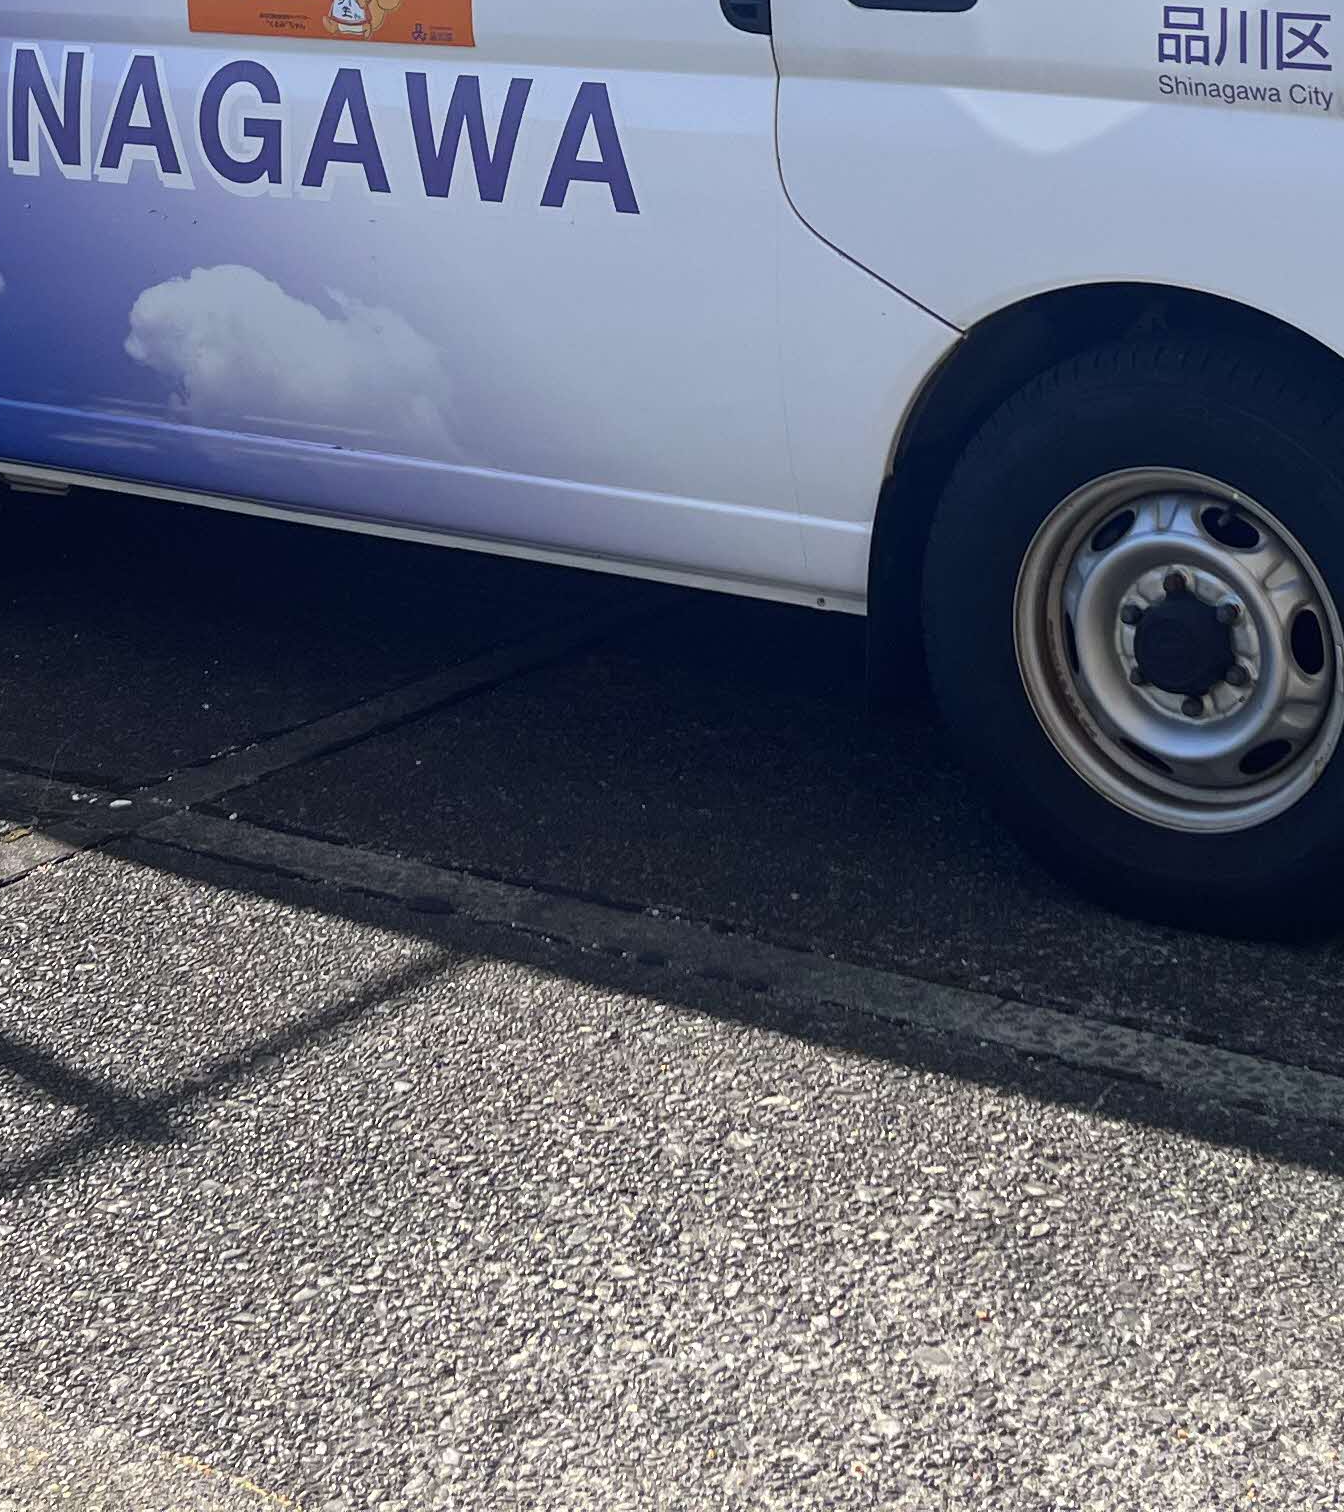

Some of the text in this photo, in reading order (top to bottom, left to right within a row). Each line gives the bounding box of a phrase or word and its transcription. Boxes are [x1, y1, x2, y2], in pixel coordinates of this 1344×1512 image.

[1158, 5, 1333, 71] 品川区
[1158, 74, 1334, 111] Shinagawa City
